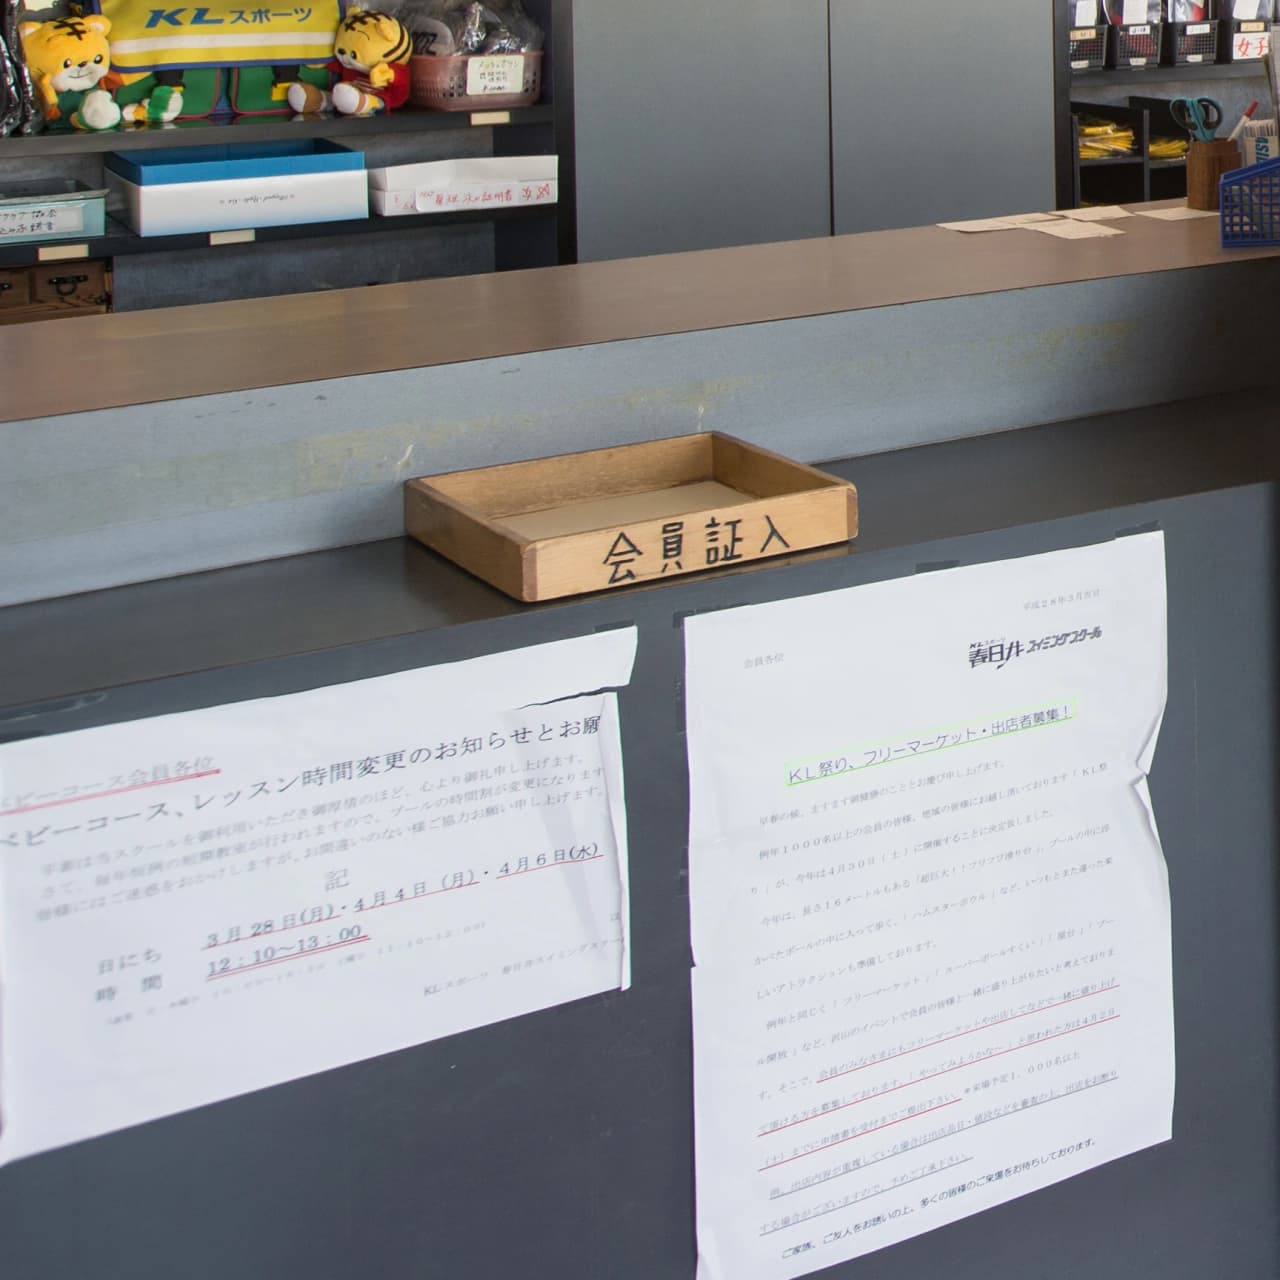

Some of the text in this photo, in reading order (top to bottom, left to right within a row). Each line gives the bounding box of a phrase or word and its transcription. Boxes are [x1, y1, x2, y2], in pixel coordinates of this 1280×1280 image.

[144, 6, 312, 28] KL スポーツ
[1236, 37, 1269, 57] 女子
[603, 514, 791, 583] 会員証入
[969, 625, 1103, 670] 春日井 スイミングスクール
[324, 868, 350, 892] 記
[97, 947, 163, 977] 日にち
